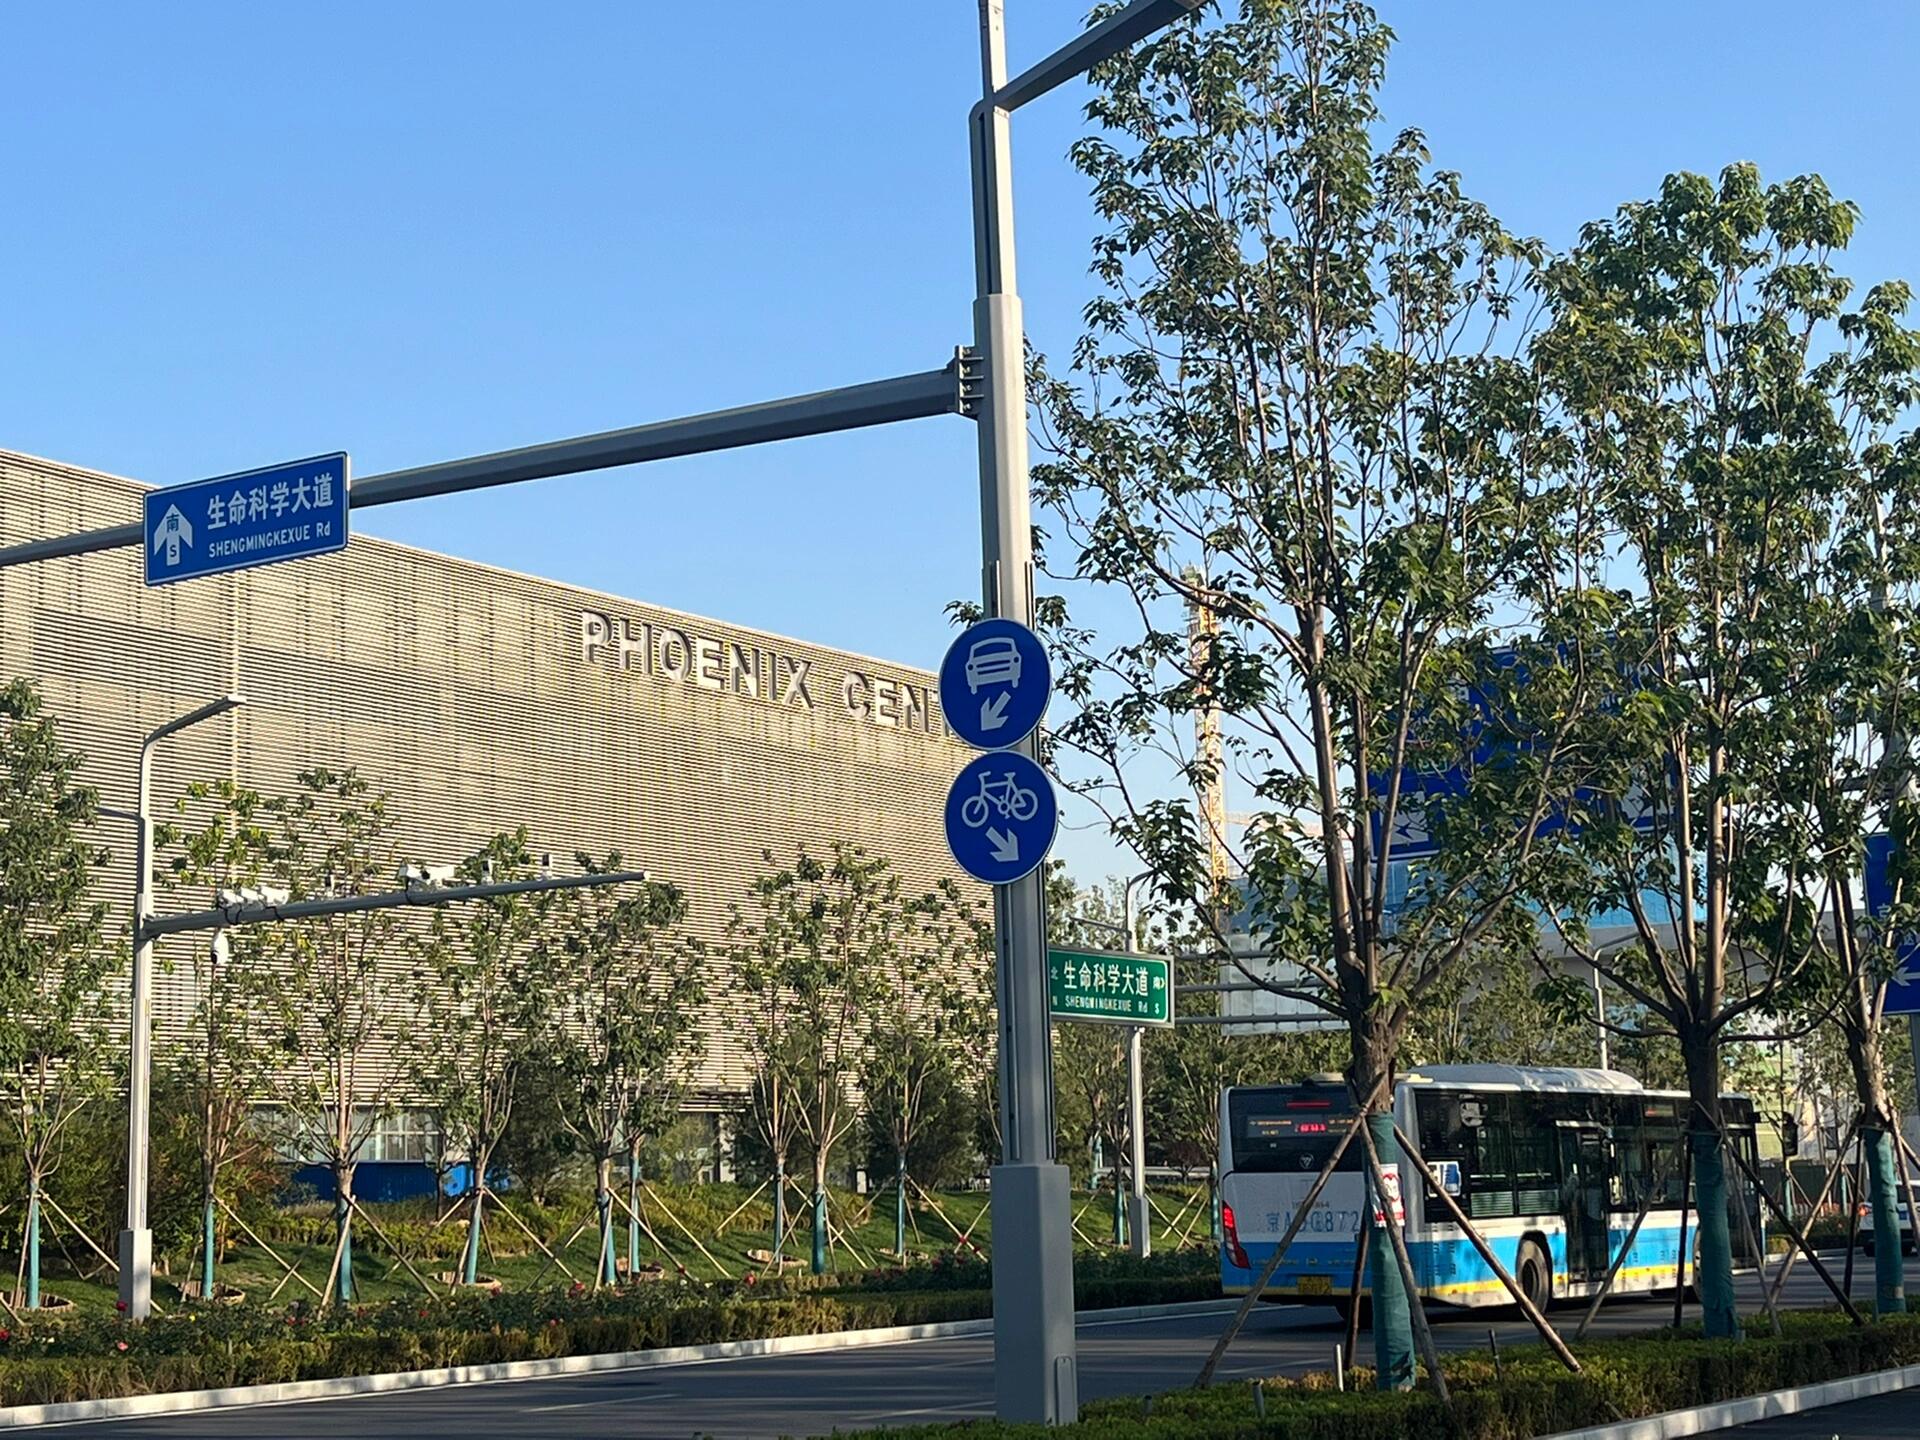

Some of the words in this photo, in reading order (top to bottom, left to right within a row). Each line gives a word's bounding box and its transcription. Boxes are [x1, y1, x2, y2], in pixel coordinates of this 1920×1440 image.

[207, 472, 334, 530] 生命科学大道
[166, 513, 180, 533] 南
[208, 525, 311, 558] SHENGMINGKEXUE
[316, 521, 331, 539] Rd
[169, 544, 178, 558] S
[582, 607, 815, 710] PHOENIX
[1063, 960, 1149, 997] 生命科学大道
[1065, 995, 1132, 1012] SHENGMINGKEXUE
[1138, 1000, 1148, 1013] Rd
